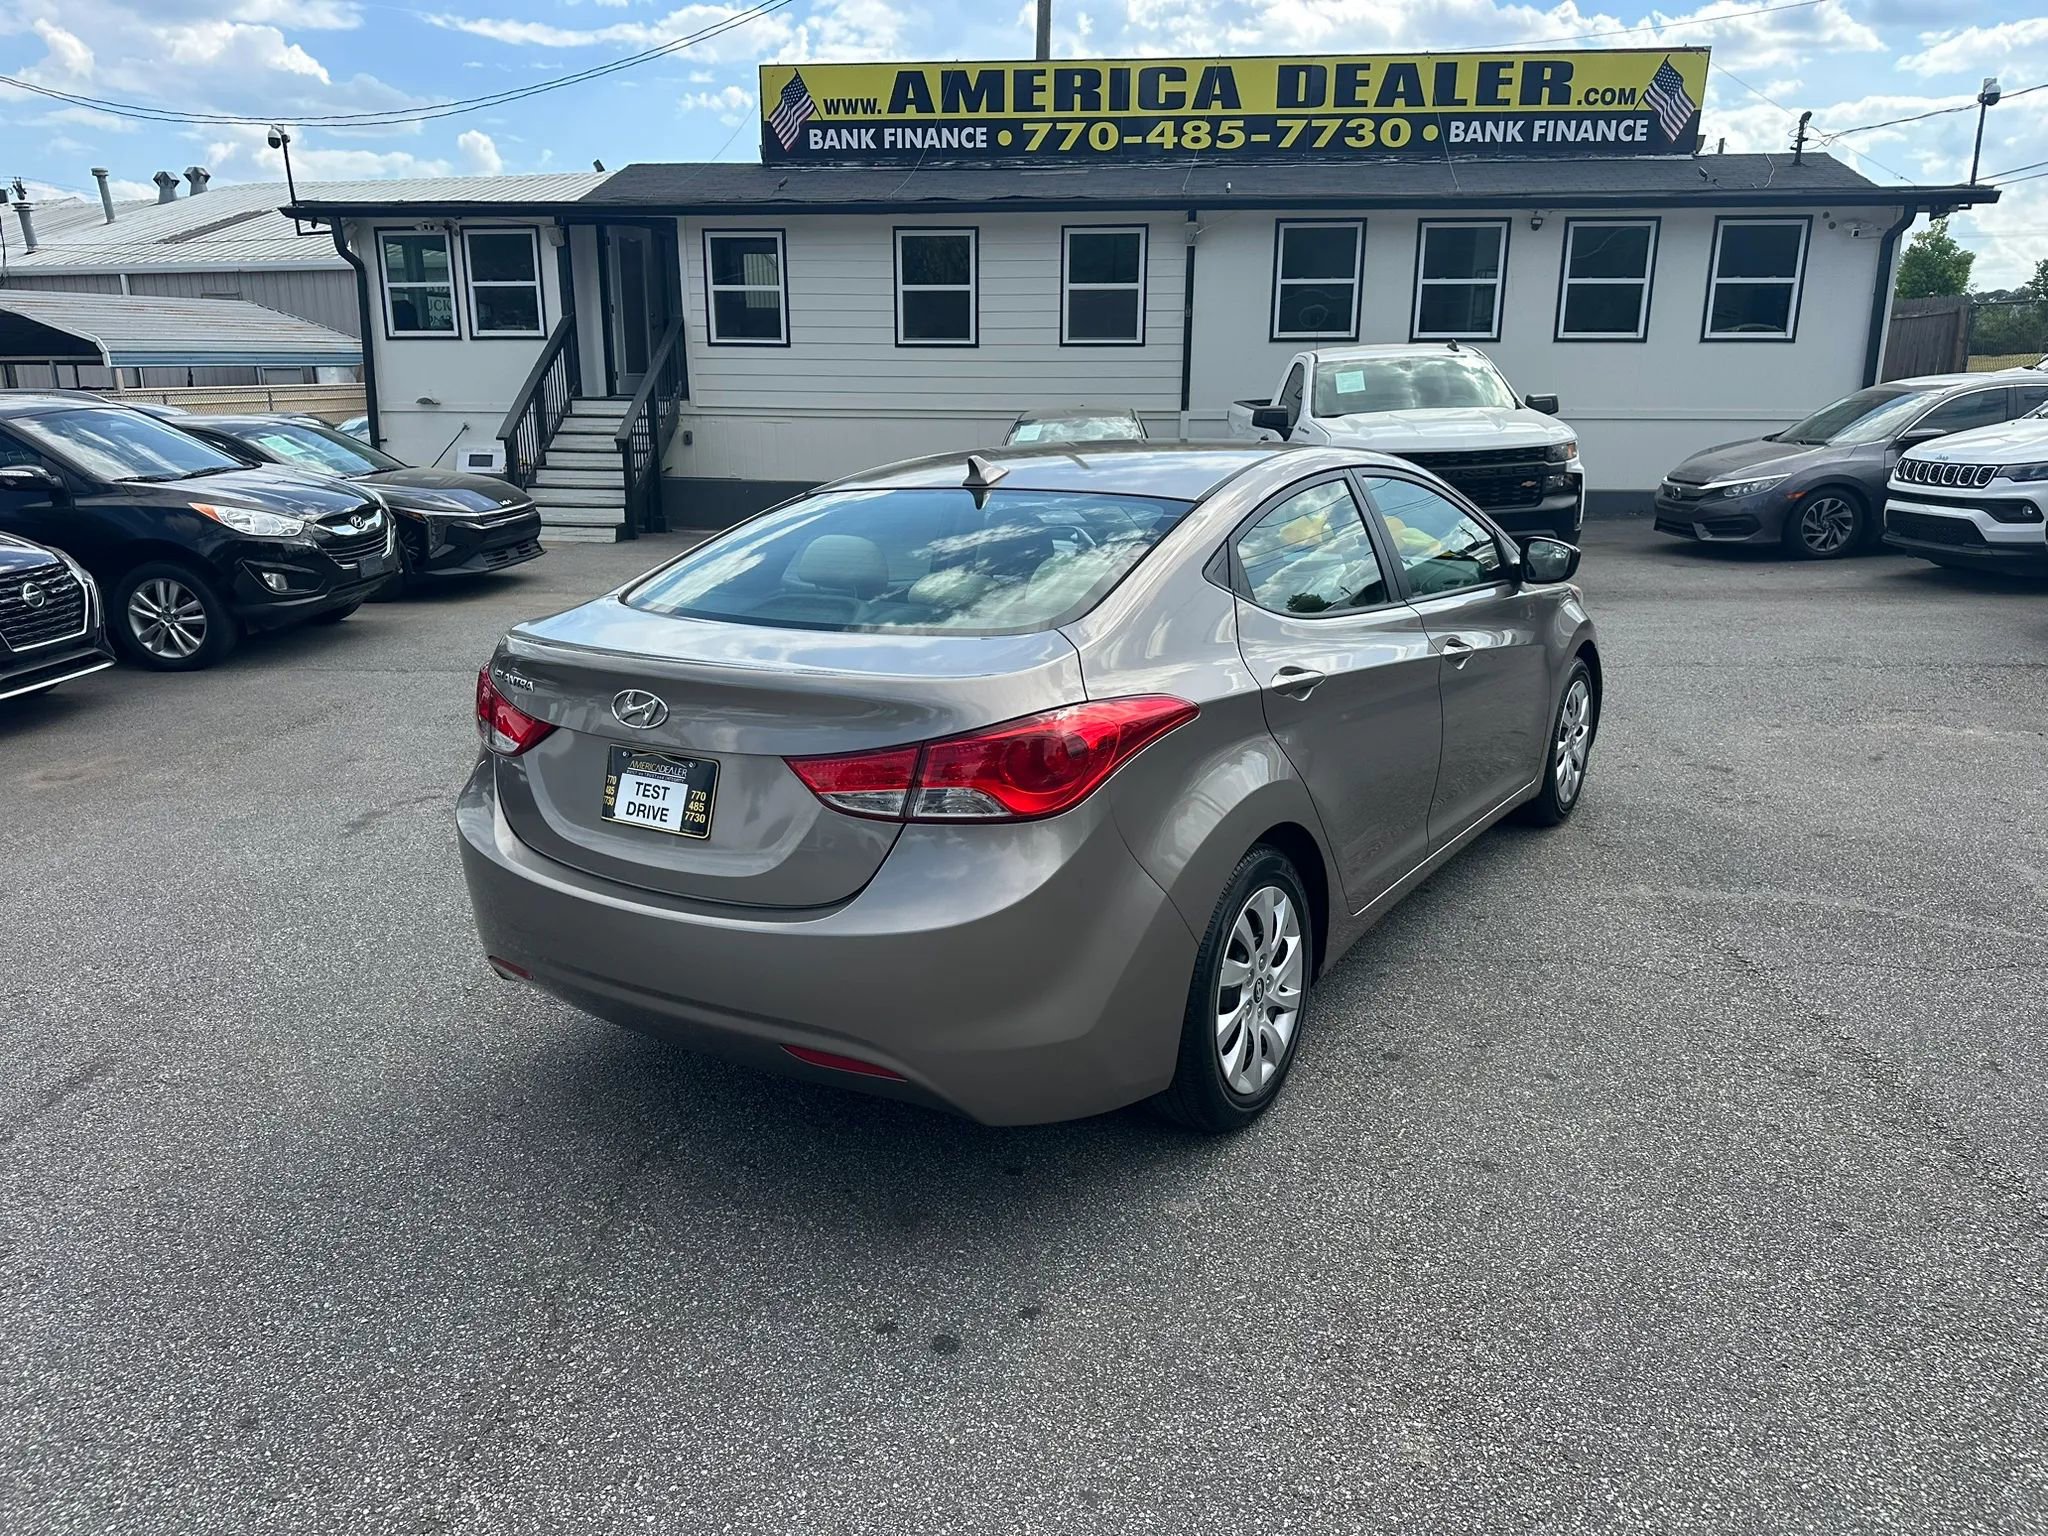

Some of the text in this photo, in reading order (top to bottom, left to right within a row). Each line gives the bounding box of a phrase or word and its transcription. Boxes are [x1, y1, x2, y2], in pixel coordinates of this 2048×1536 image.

[809, 118, 1648, 152] BANK FINANCE 770-485-7730 BANK FINANCE
[635, 781, 670, 801] TEST
[691, 790, 706, 801] 770
[626, 801, 669, 823] DRIVE
[689, 801, 705, 812] 485
[685, 811, 706, 824] 7730
